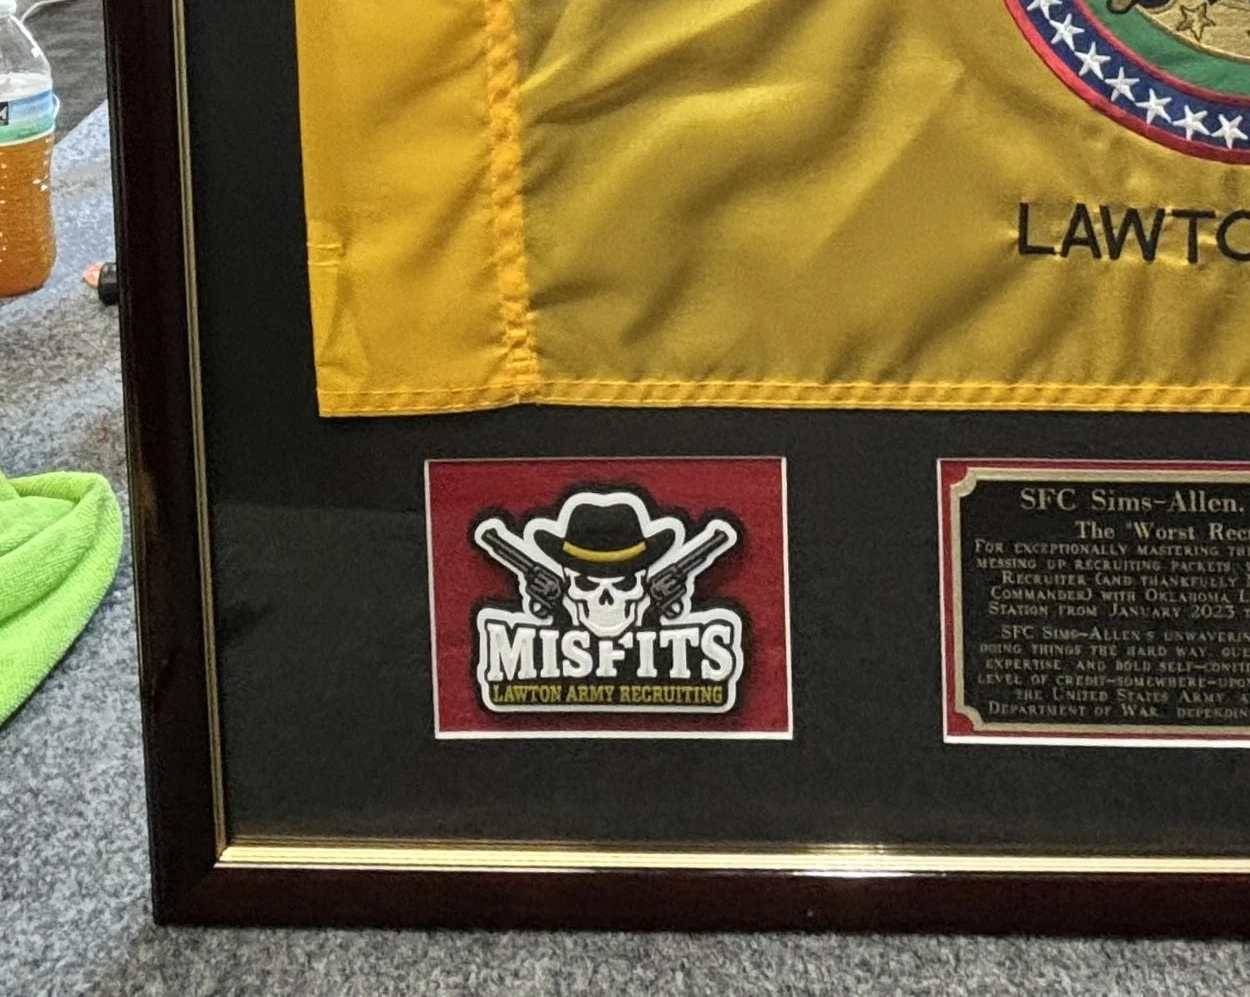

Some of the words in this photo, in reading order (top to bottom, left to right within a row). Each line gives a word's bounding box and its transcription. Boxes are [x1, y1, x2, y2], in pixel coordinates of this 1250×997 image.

[1020, 487, 1076, 511] SFC
[1076, 520, 1115, 539] The
[1126, 522, 1196, 541] "Worst
[975, 539, 1004, 553] FOR
[1014, 543, 1128, 555] EXCEPTIONALLY
[1137, 545, 1219, 556] MASTERING
[976, 558, 1036, 569] MESSING
[1047, 559, 1066, 569] UP
[1075, 559, 1161, 571] RECRUITING
[1002, 570, 1086, 585] RECRUITER
[1140, 575, 1237, 587] THANKFULLY
[991, 586, 1092, 600] COMMANDER)
[1100, 591, 1136, 602] WITH
[1145, 588, 1231, 603] OKLAHOMA
[988, 601, 1048, 616] STATION
[1059, 605, 1097, 616] FROM
[1108, 603, 1182, 618] JANUARY
[1001, 625, 1034, 640] SFC
[487, 622, 735, 682] MISFITS
[980, 643, 1022, 654] DOING
[1031, 644, 1082, 656] THINGS
[1090, 645, 1117, 657] THE
[1126, 645, 1168, 657] HARD
[1076, 660, 1106, 672] AND
[978, 673, 1023, 685] LEVEL
[1031, 674, 1048, 685] OF
[492, 684, 562, 702] LAWTON
[565, 685, 614, 703] ARMY
[620, 685, 723, 703] RECRUITING
